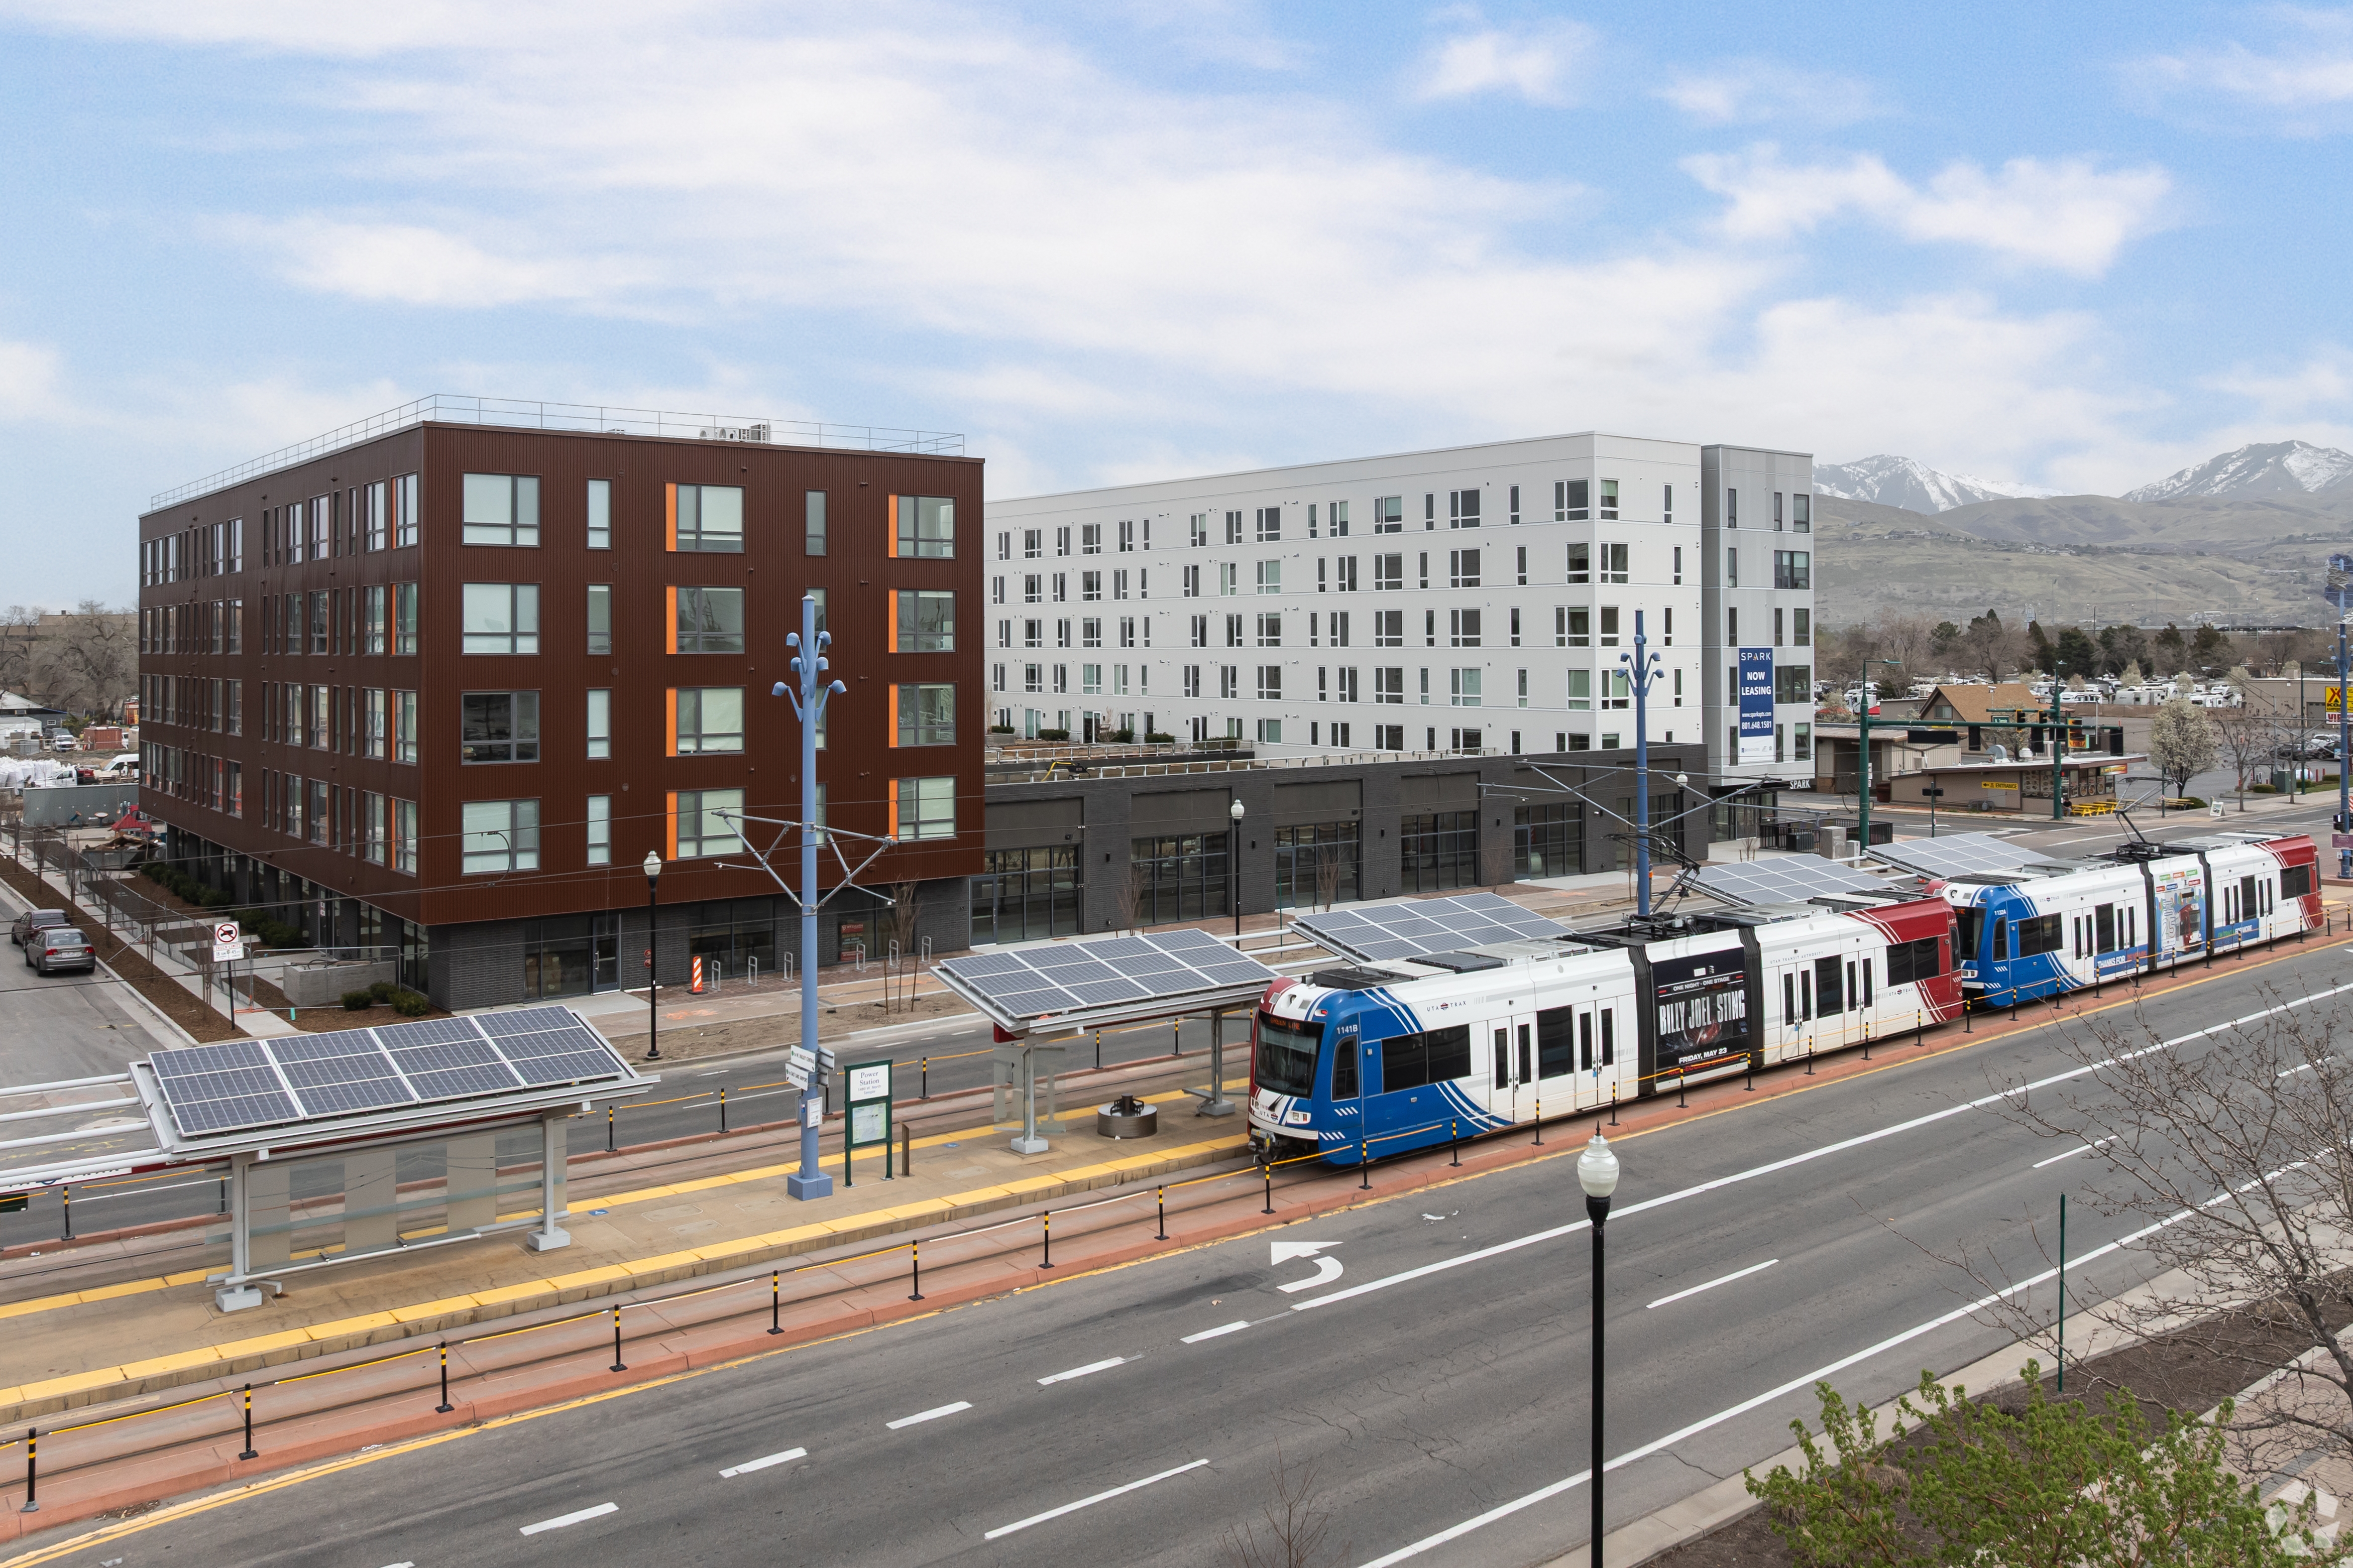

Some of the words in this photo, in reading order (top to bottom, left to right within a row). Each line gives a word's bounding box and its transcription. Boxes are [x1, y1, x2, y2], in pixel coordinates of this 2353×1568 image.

[1741, 652, 1771, 661] SPARK
[1747, 671, 1765, 680] NOW
[1741, 686, 1771, 695] LEASING
[1741, 720, 1772, 730] 801.648.1581
[1789, 779, 1811, 790] SPARK
[2097, 957, 2115, 968] THANKS
[2116, 955, 2125, 964] FOR
[1714, 976, 1730, 984] STAGE
[1659, 1001, 1685, 1036] BILLY
[1689, 996, 1712, 1029] JOEL
[1717, 989, 1745, 1023] STING
[1270, 1017, 1286, 1026] GREEN
[1288, 1022, 1300, 1030] LINE
[1336, 1024, 1358, 1035] 1141B
[1678, 1053, 1703, 1064] FRIDAY,
[1704, 1049, 1718, 1058] MAY
[859, 1078, 879, 1086] Station
